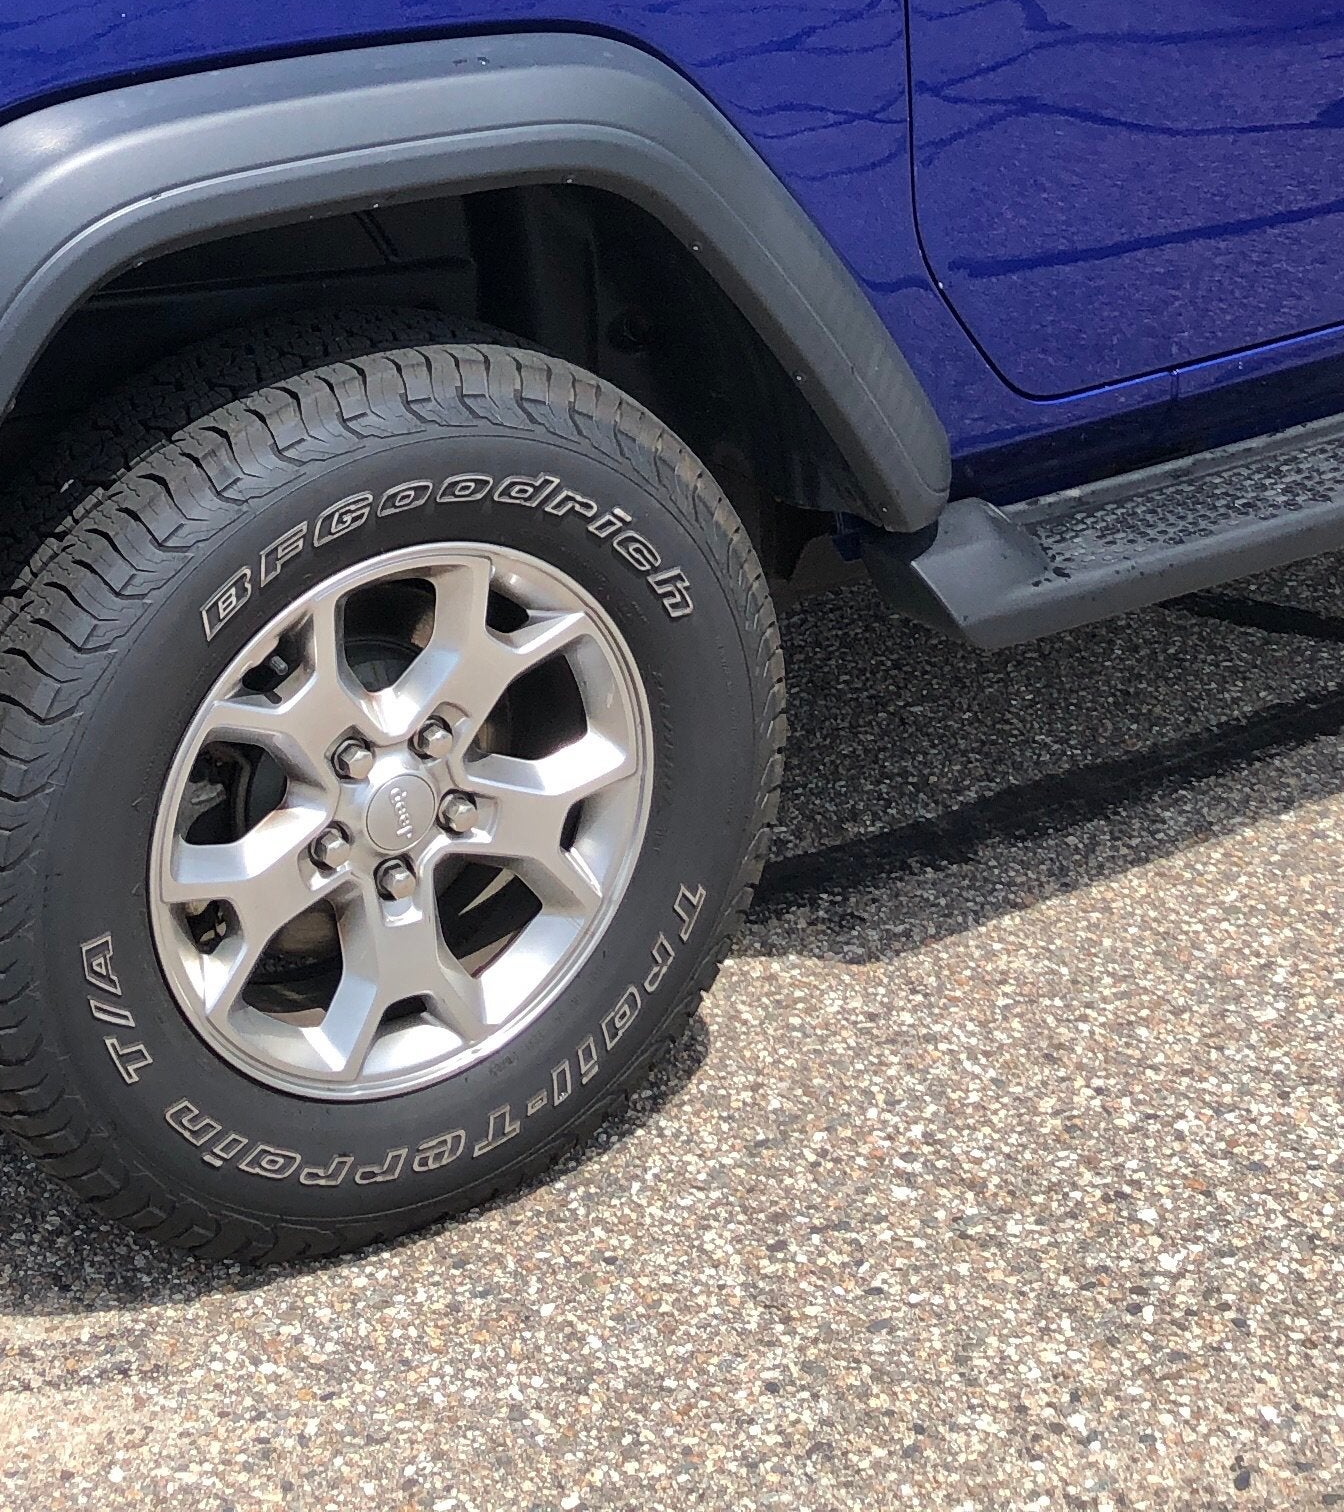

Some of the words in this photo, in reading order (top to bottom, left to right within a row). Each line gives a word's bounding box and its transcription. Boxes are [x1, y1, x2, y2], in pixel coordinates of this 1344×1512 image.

[199, 471, 695, 643] BFGoodrich
[390, 788, 413, 838] Jeep
[80, 931, 154, 1086] T/A
[164, 883, 708, 1186] Trail-Terrain
